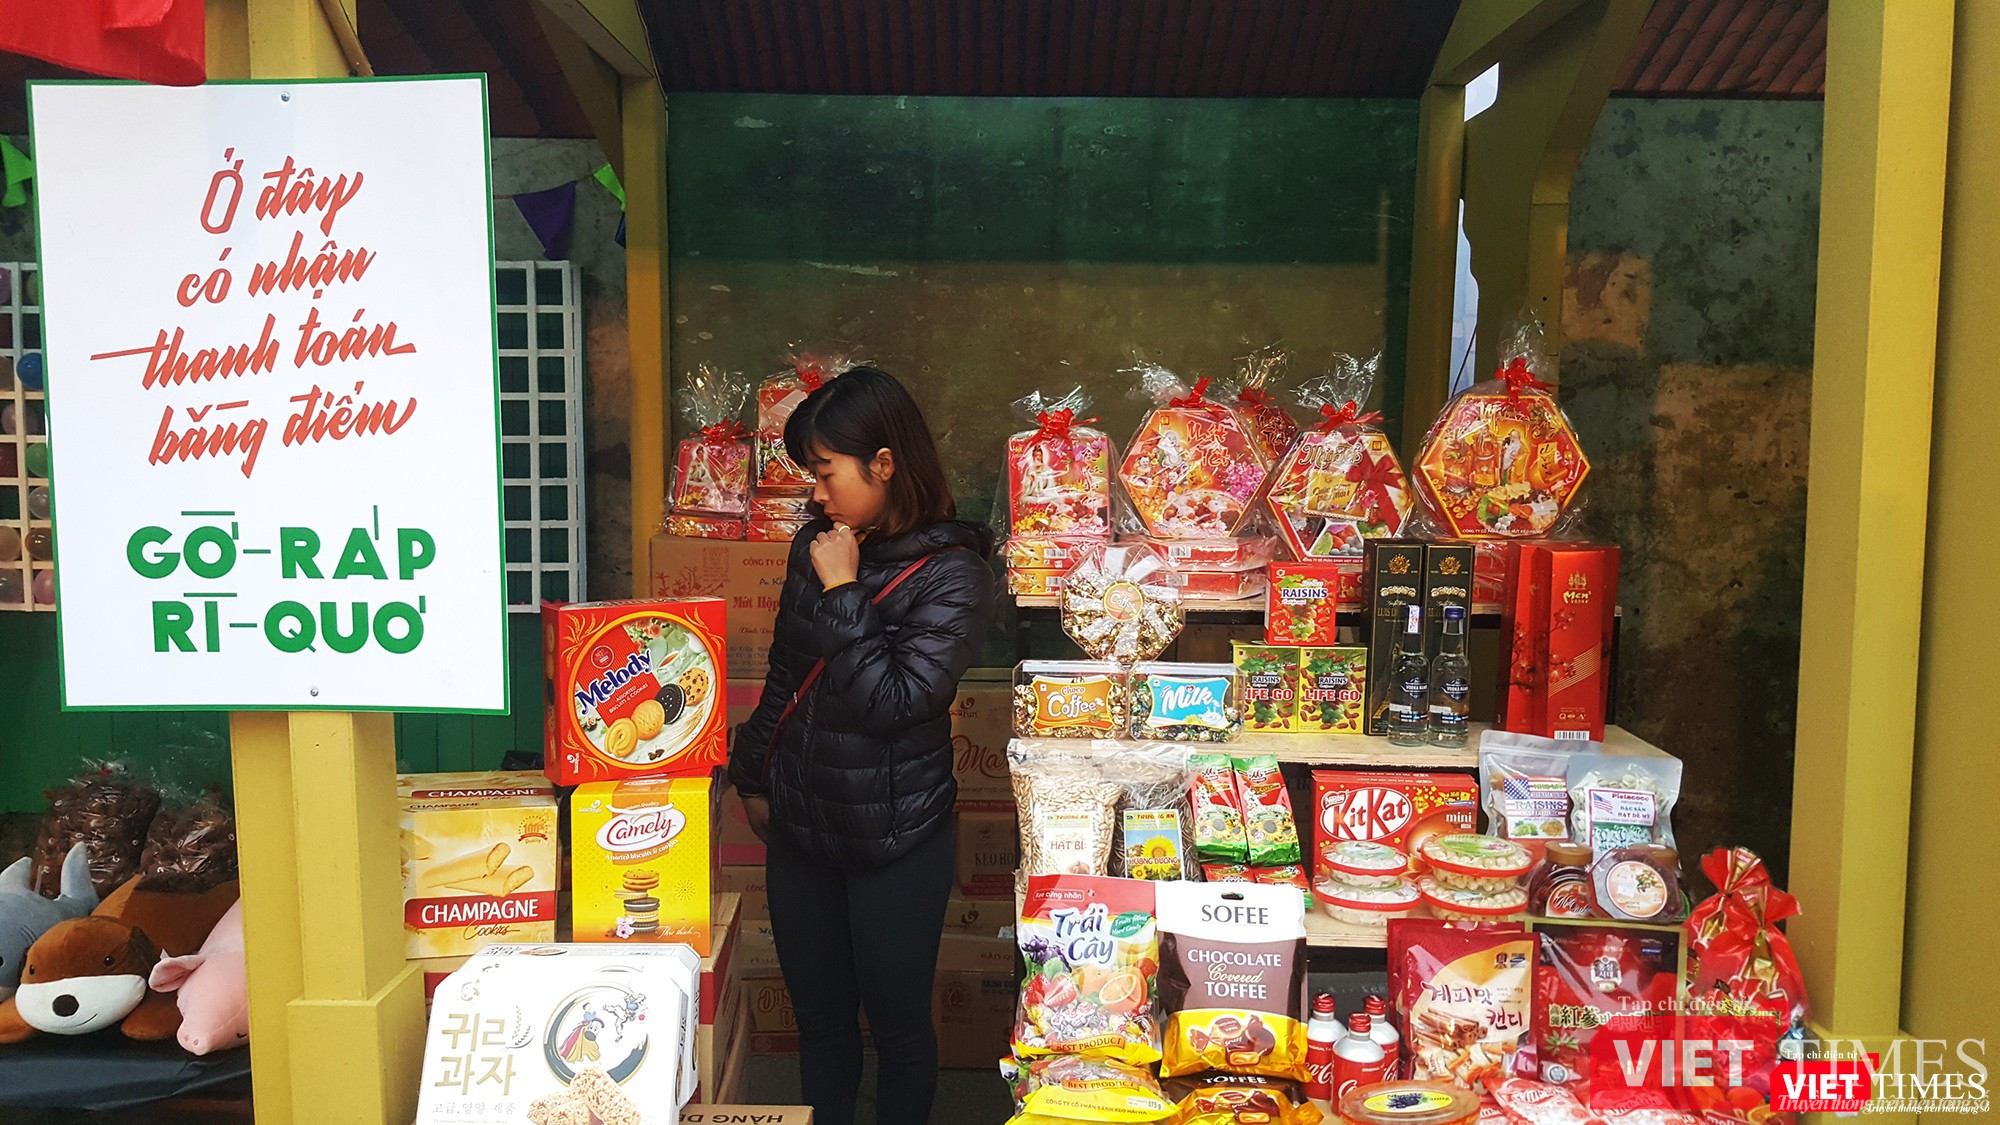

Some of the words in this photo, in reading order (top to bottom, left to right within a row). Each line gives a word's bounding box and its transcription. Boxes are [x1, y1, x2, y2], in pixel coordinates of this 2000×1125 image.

[256, 156, 363, 237] đây
[176, 247, 232, 307] có
[248, 230, 377, 299] nhận
[90, 313, 280, 390] thanh
[294, 307, 416, 368] toán
[148, 400, 268, 478] bằng
[282, 380, 418, 447] điểm
[1281, 587, 1328, 599] RAISINS
[574, 648, 653, 716] Melody
[1062, 686, 1085, 694] Choco
[1252, 676, 1281, 684] RAISINS
[1047, 692, 1098, 718] Coffee
[1162, 687, 1214, 715] Milk
[1272, 689, 1293, 700] GO
[1304, 690, 1333, 700] LIFE
[1339, 690, 1361, 700] GO
[428, 788, 539, 798] CHAMPAGNE
[1515, 801, 1564, 810] RAISINS
[1446, 811, 1472, 823] mini
[606, 811, 677, 846] Camely
[606, 853, 629, 861] Assorted
[1045, 890, 1062, 900] cứng
[1064, 890, 1082, 900] nhân
[421, 899, 539, 924] CHAMPAGNE
[1201, 904, 1269, 926] SOFEE
[463, 919, 520, 941] Cookies
[1054, 907, 1104, 938] Trái
[1068, 937, 1113, 965] Cây
[1187, 949, 1281, 967] CHOCOLATE
[1207, 963, 1264, 984] Covered
[1204, 981, 1267, 1000] TOFFEE
[1421, 981, 1493, 1005] 계피맛
[1486, 1006, 1523, 1030] 캔디
[442, 1013, 506, 1052] 귀리
[1057, 1043, 1077, 1051] BEST
[1079, 1038, 1121, 1050] PRODUCT
[434, 1054, 517, 1096] 과자
[1067, 1081, 1087, 1089] BEST
[1202, 1075, 1267, 1085] TOFFEE
[1046, 1098, 1062, 1106] CÔNG
[1148, 1100, 1157, 1109] 375
